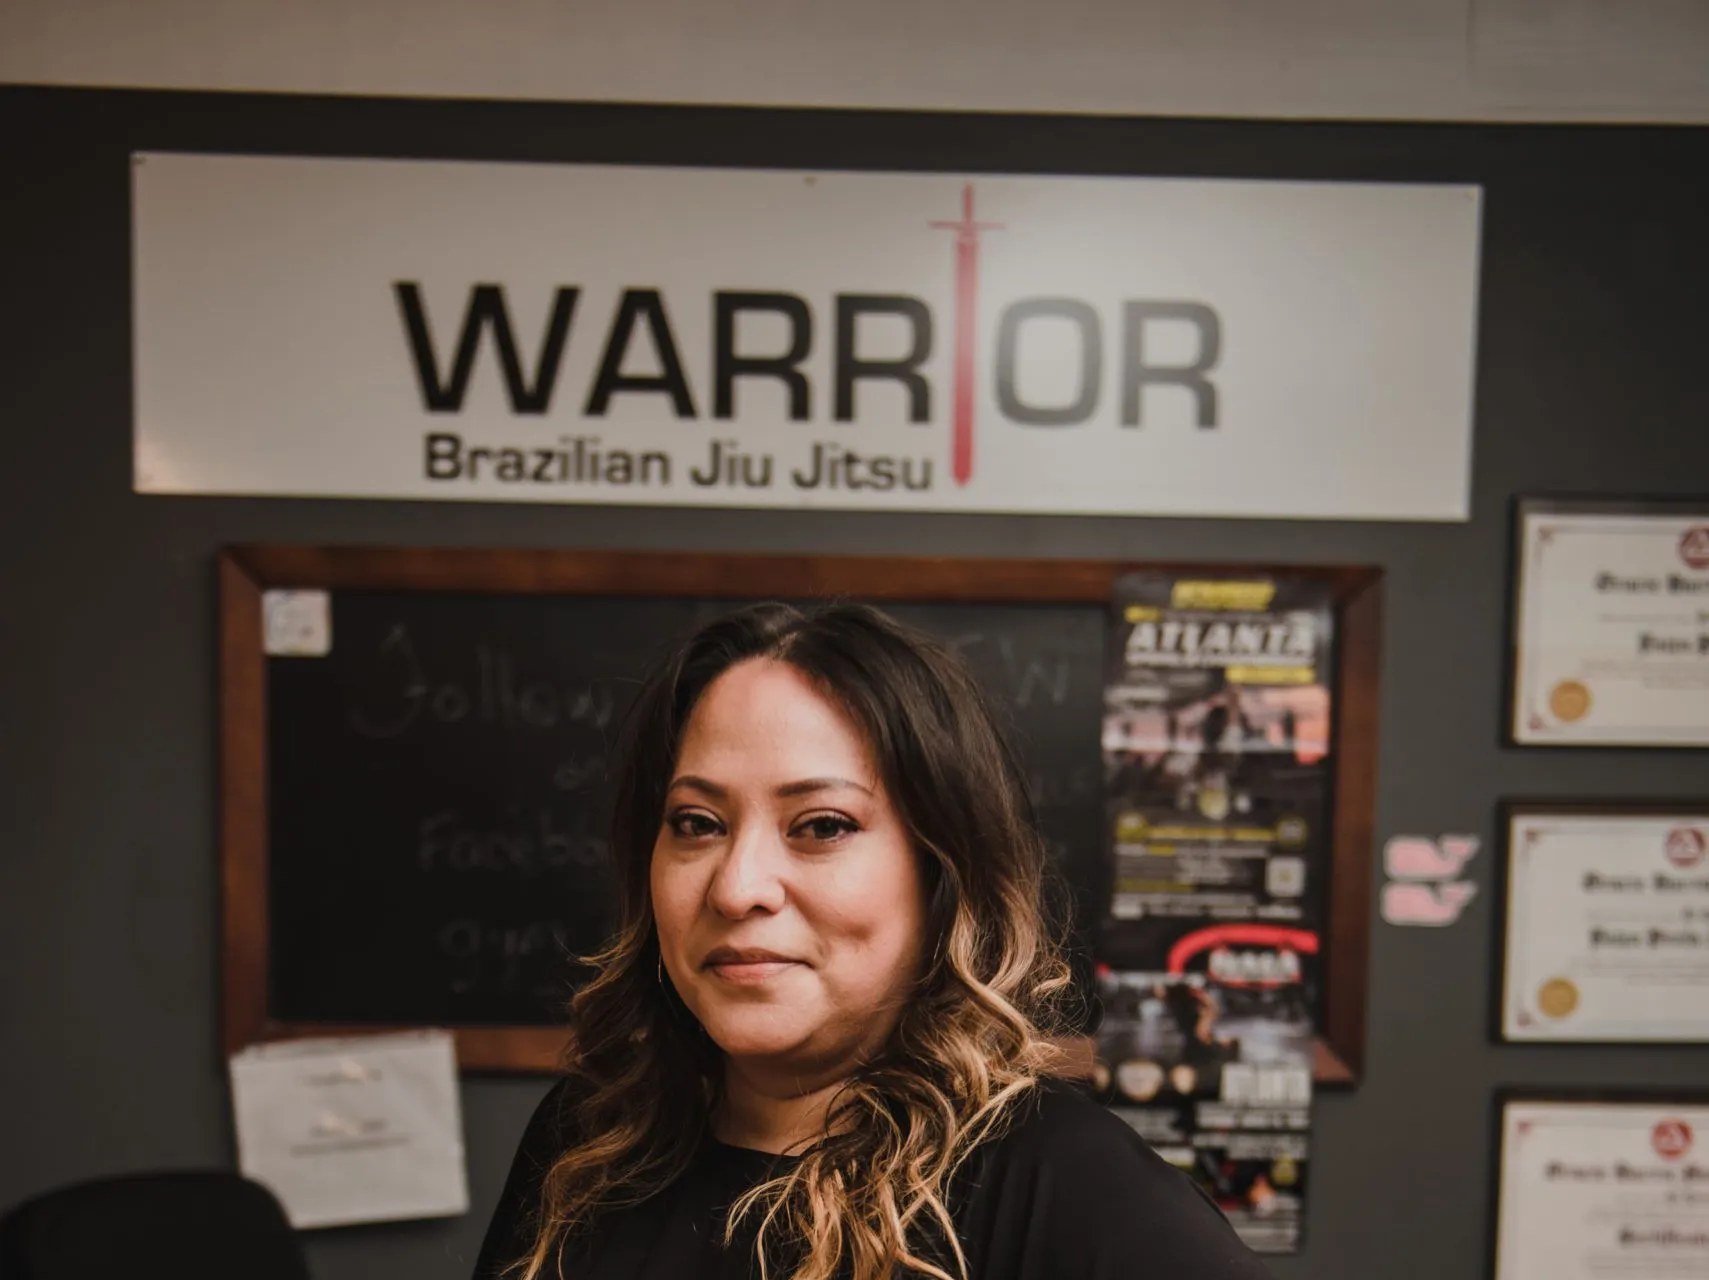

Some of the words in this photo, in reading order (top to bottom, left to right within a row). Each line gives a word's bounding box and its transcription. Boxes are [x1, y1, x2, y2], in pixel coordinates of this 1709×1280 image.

[422, 430, 671, 486] Brazilian
[689, 439, 773, 488] Jiu
[792, 442, 932, 491] Jitsu
[1126, 613, 1315, 664] ATLANTA
